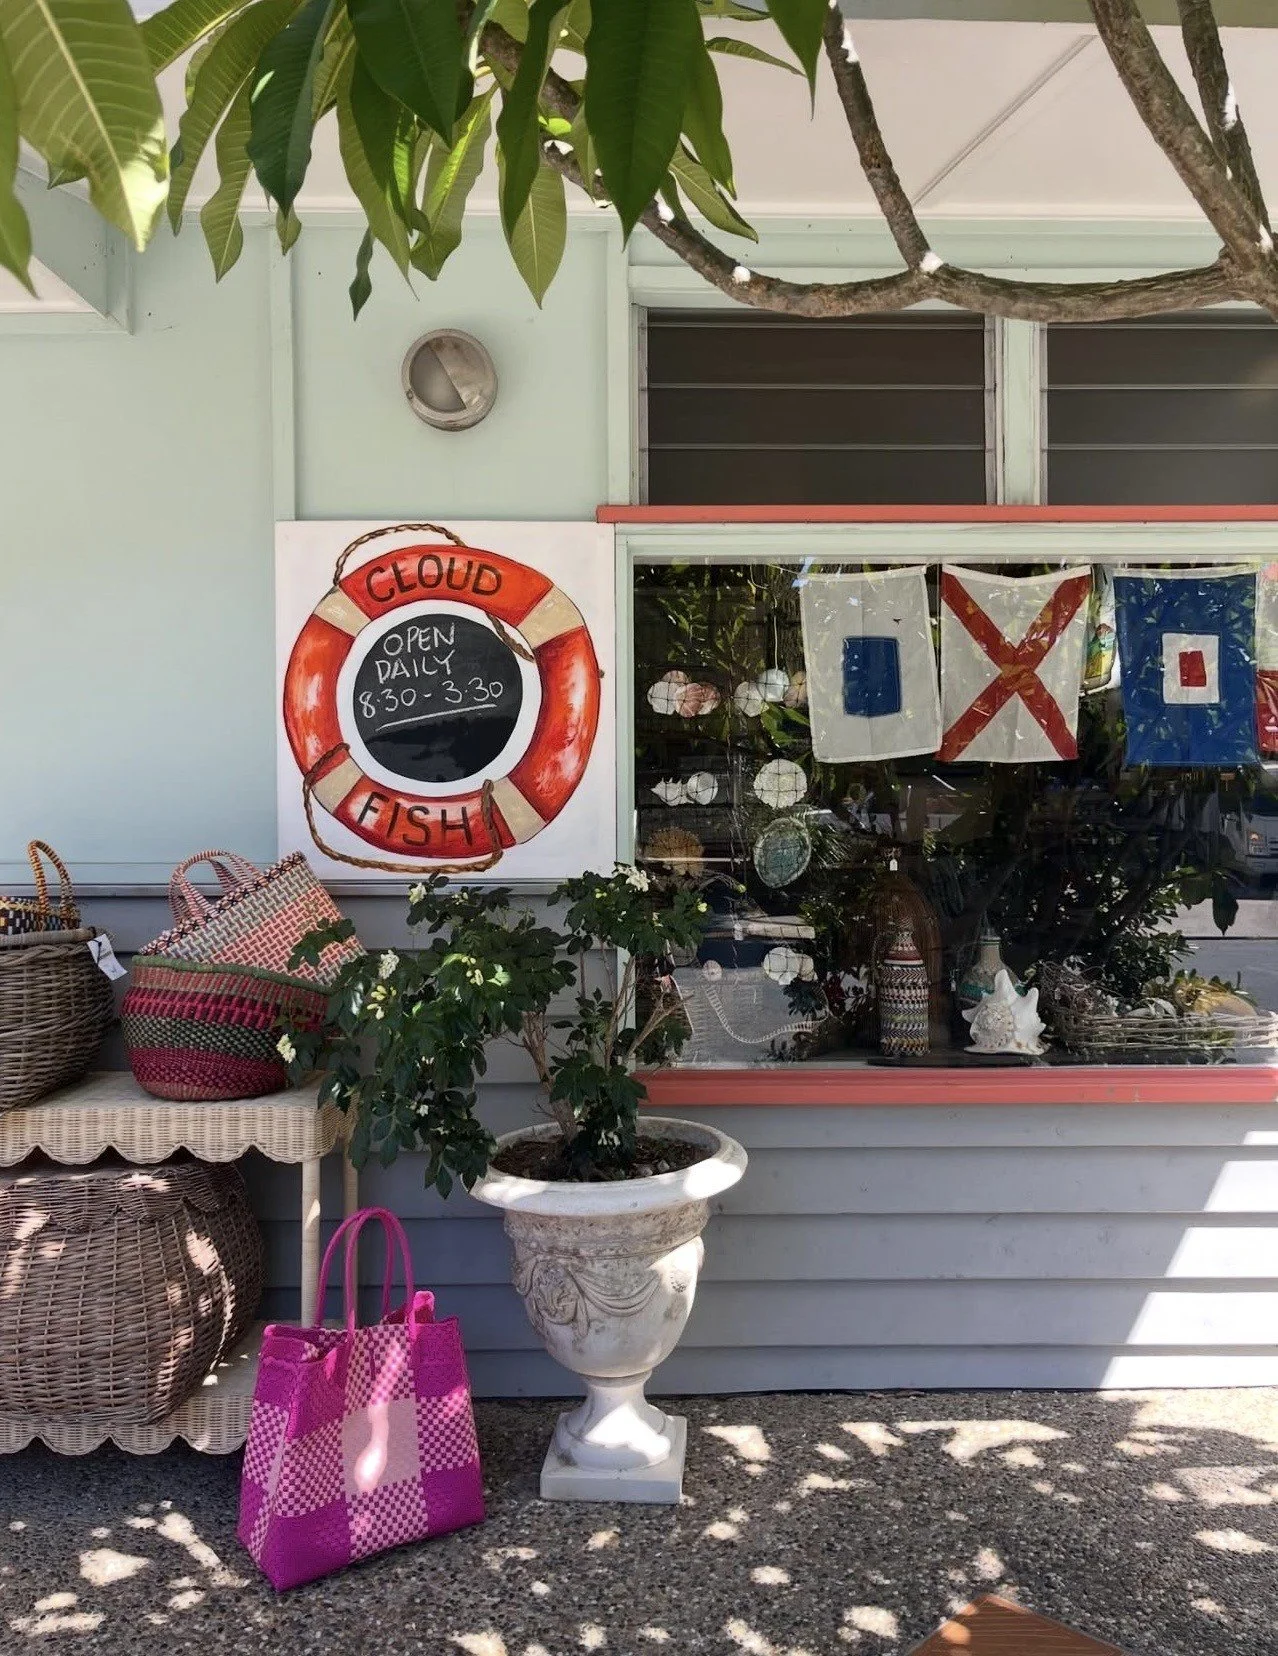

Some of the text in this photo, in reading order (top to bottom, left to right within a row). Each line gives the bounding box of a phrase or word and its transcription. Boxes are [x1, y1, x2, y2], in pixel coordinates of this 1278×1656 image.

[365, 554, 502, 603] CLOUD
[384, 622, 455, 656] OPEN
[375, 650, 456, 684] DAILY
[357, 791, 474, 847] FISH
